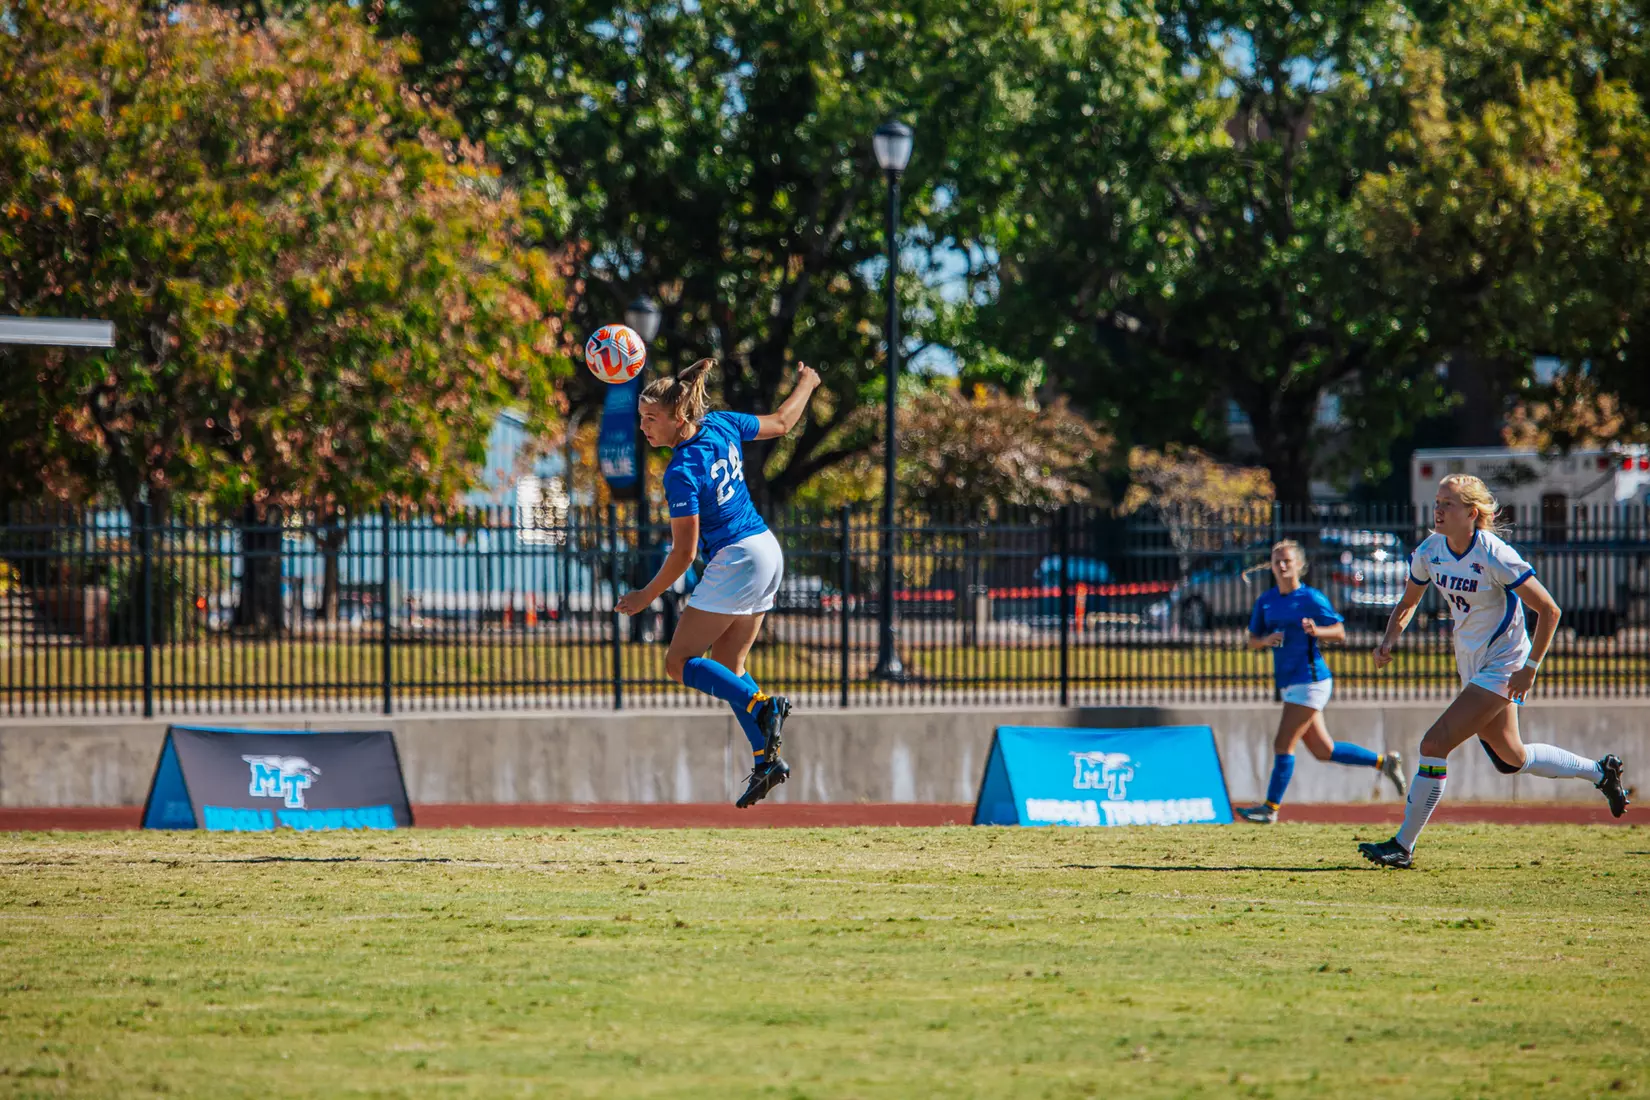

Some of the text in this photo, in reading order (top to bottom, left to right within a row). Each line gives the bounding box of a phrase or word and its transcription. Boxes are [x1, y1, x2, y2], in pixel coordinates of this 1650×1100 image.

[710, 440, 744, 506] 24
[1436, 572, 1478, 592] LA TECH
[249, 759, 312, 808] MT
[1073, 757, 1134, 800] MT
